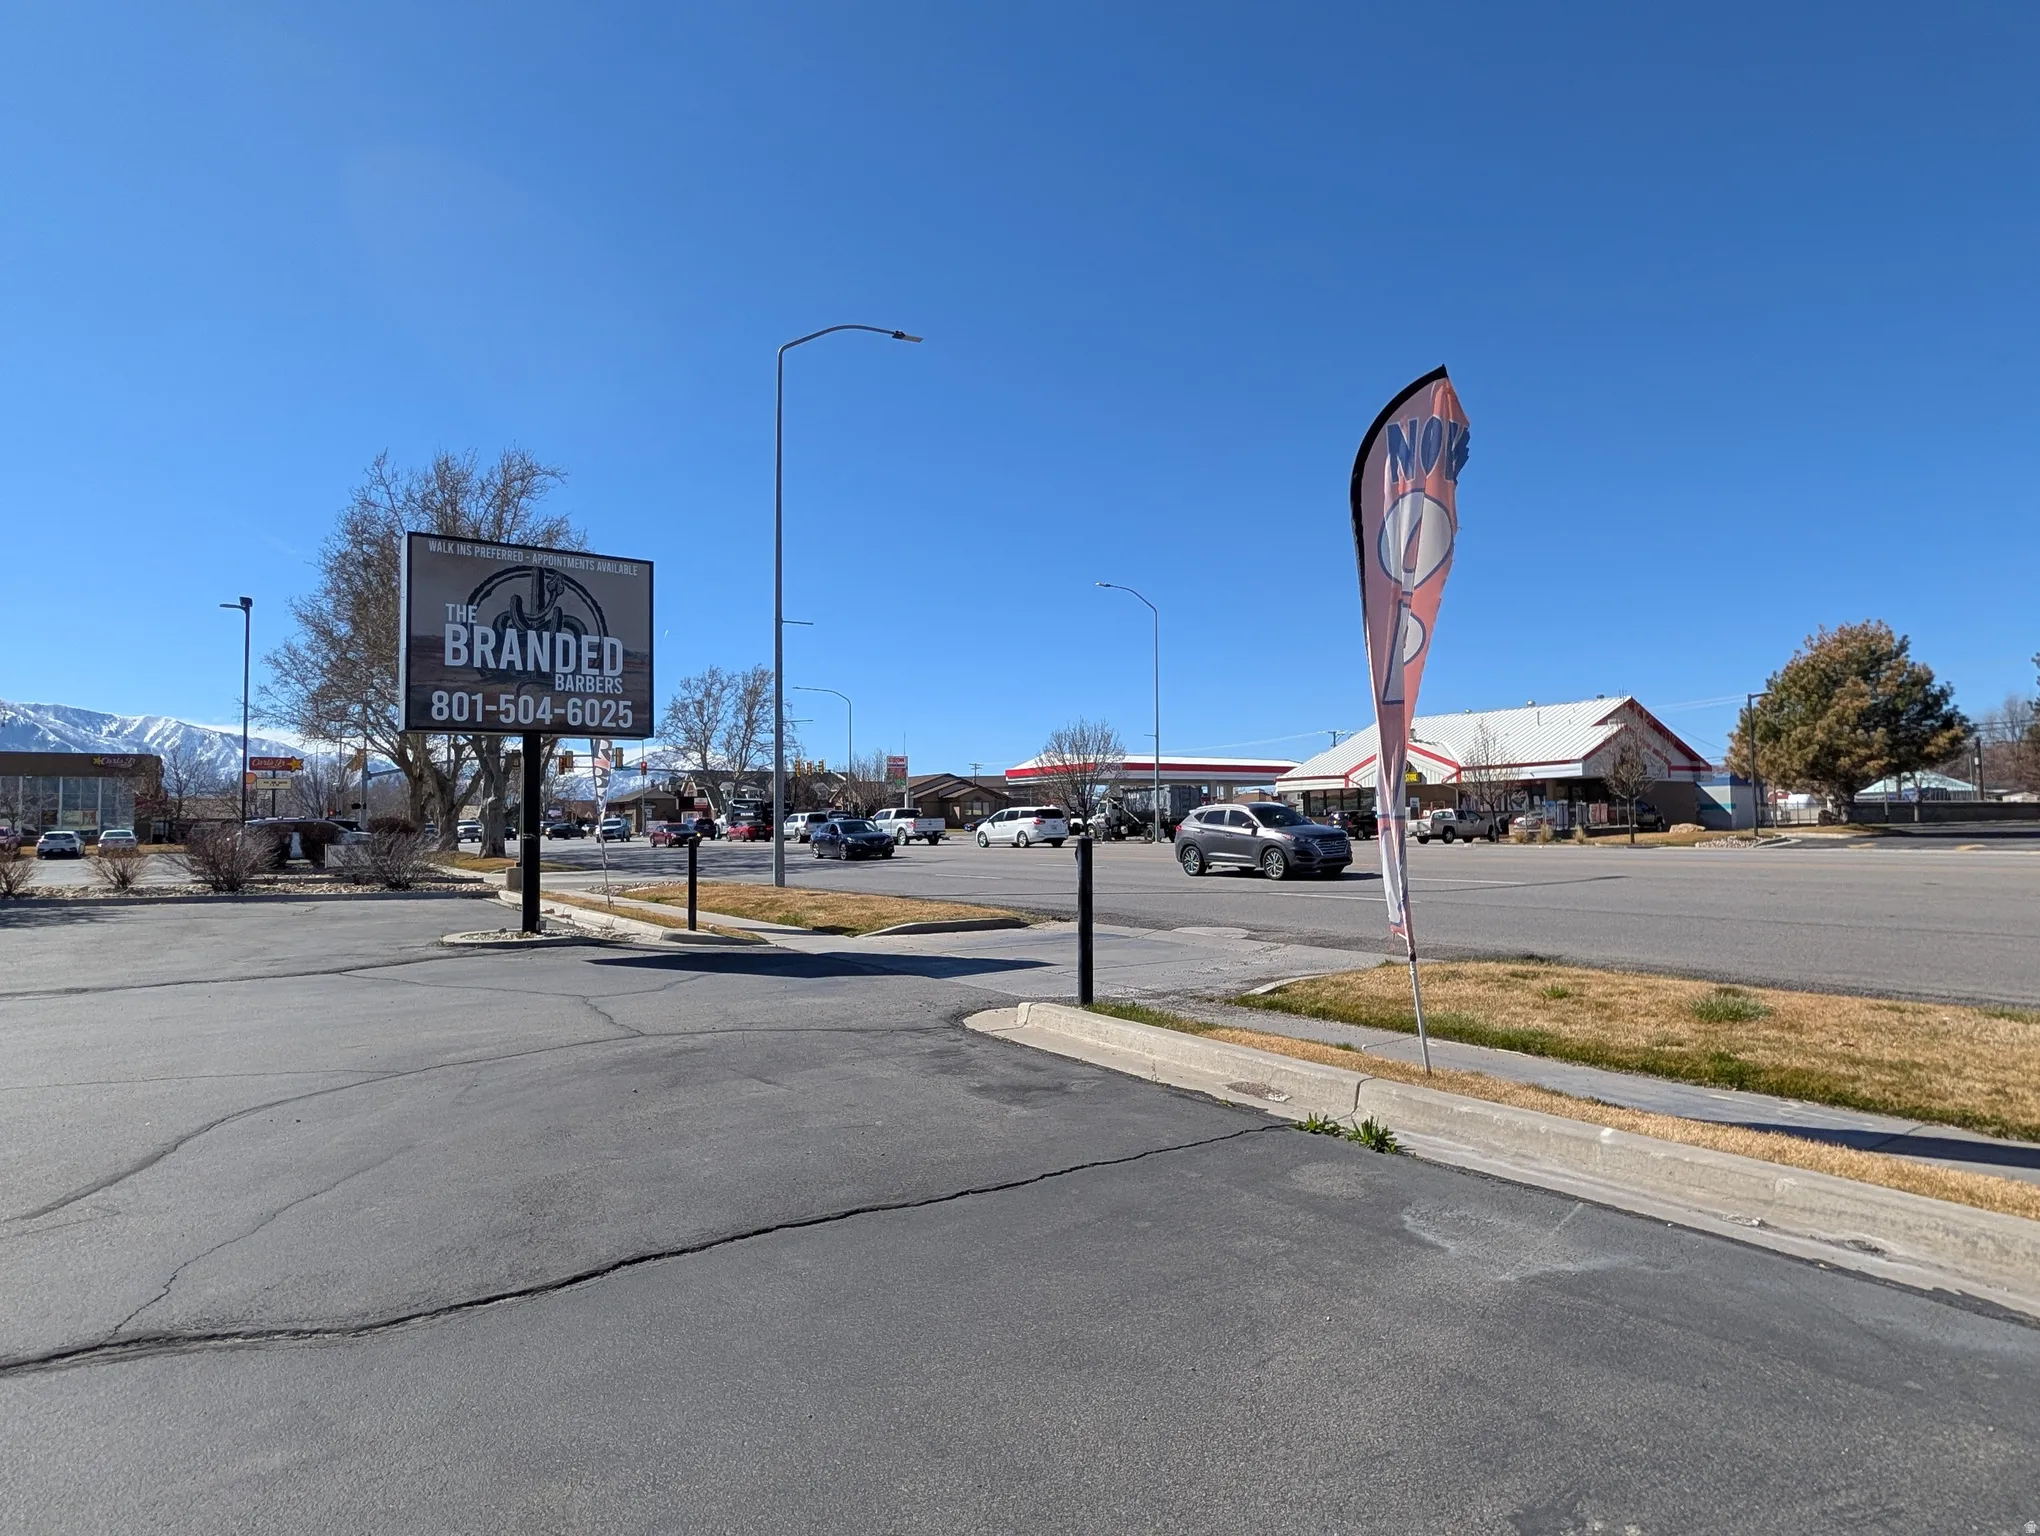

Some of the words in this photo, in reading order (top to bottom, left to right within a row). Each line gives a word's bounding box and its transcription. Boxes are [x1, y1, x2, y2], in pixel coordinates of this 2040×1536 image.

[428, 540, 454, 555] WALK
[456, 544, 473, 557] INS
[474, 545, 524, 562] PREFERRED
[532, 553, 595, 571] APPOINTMENTS
[596, 562, 638, 577] AVAILABLE
[445, 603, 477, 624] THE
[444, 624, 624, 677] BRANDED
[554, 673, 623, 695] BARBERS
[431, 690, 633, 728] 801-504-6025
